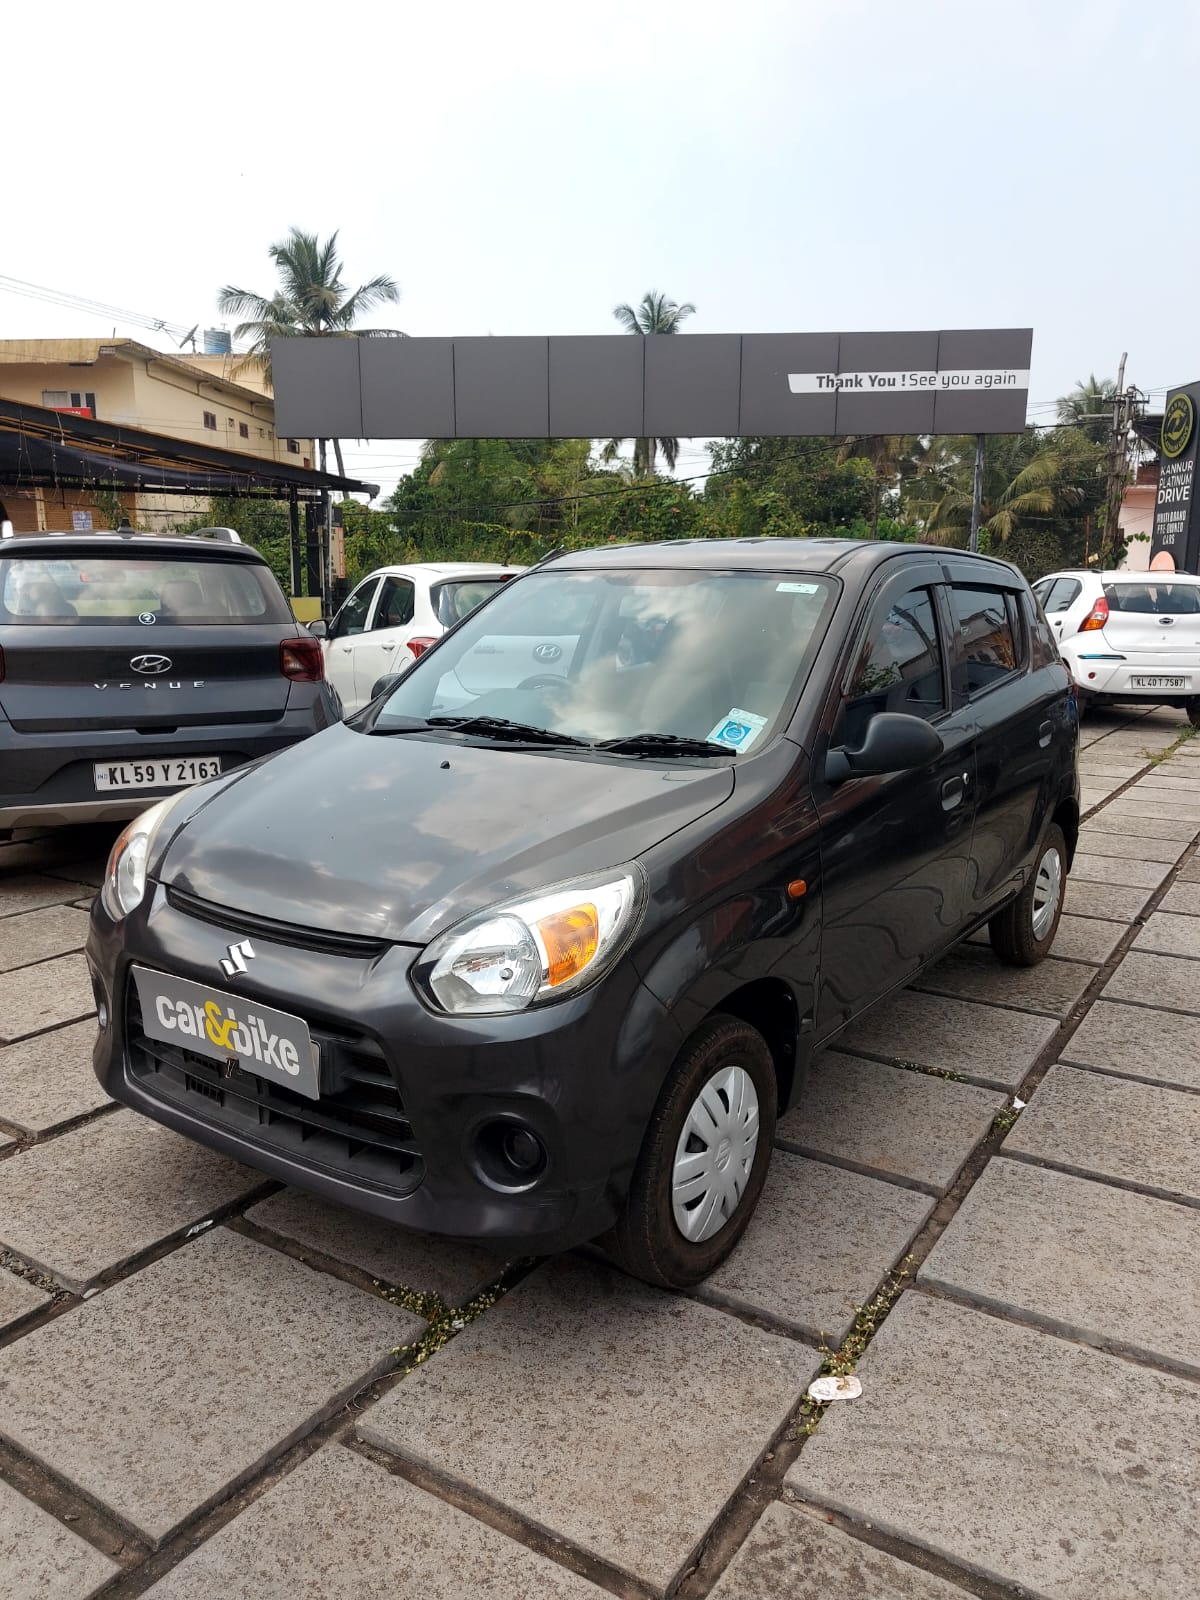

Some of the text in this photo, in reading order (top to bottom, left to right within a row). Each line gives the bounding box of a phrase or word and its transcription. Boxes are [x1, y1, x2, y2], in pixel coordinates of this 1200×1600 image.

[816, 375, 863, 388] Thank
[868, 375, 896, 388] You
[941, 373, 970, 388] you
[974, 370, 1016, 388] again
[1160, 460, 1194, 476] KANNUR
[1159, 473, 1193, 489] PLATINUM
[1157, 485, 1191, 505] DRIVE
[94, 681, 205, 690] VENUE
[176, 761, 219, 780] 2163
